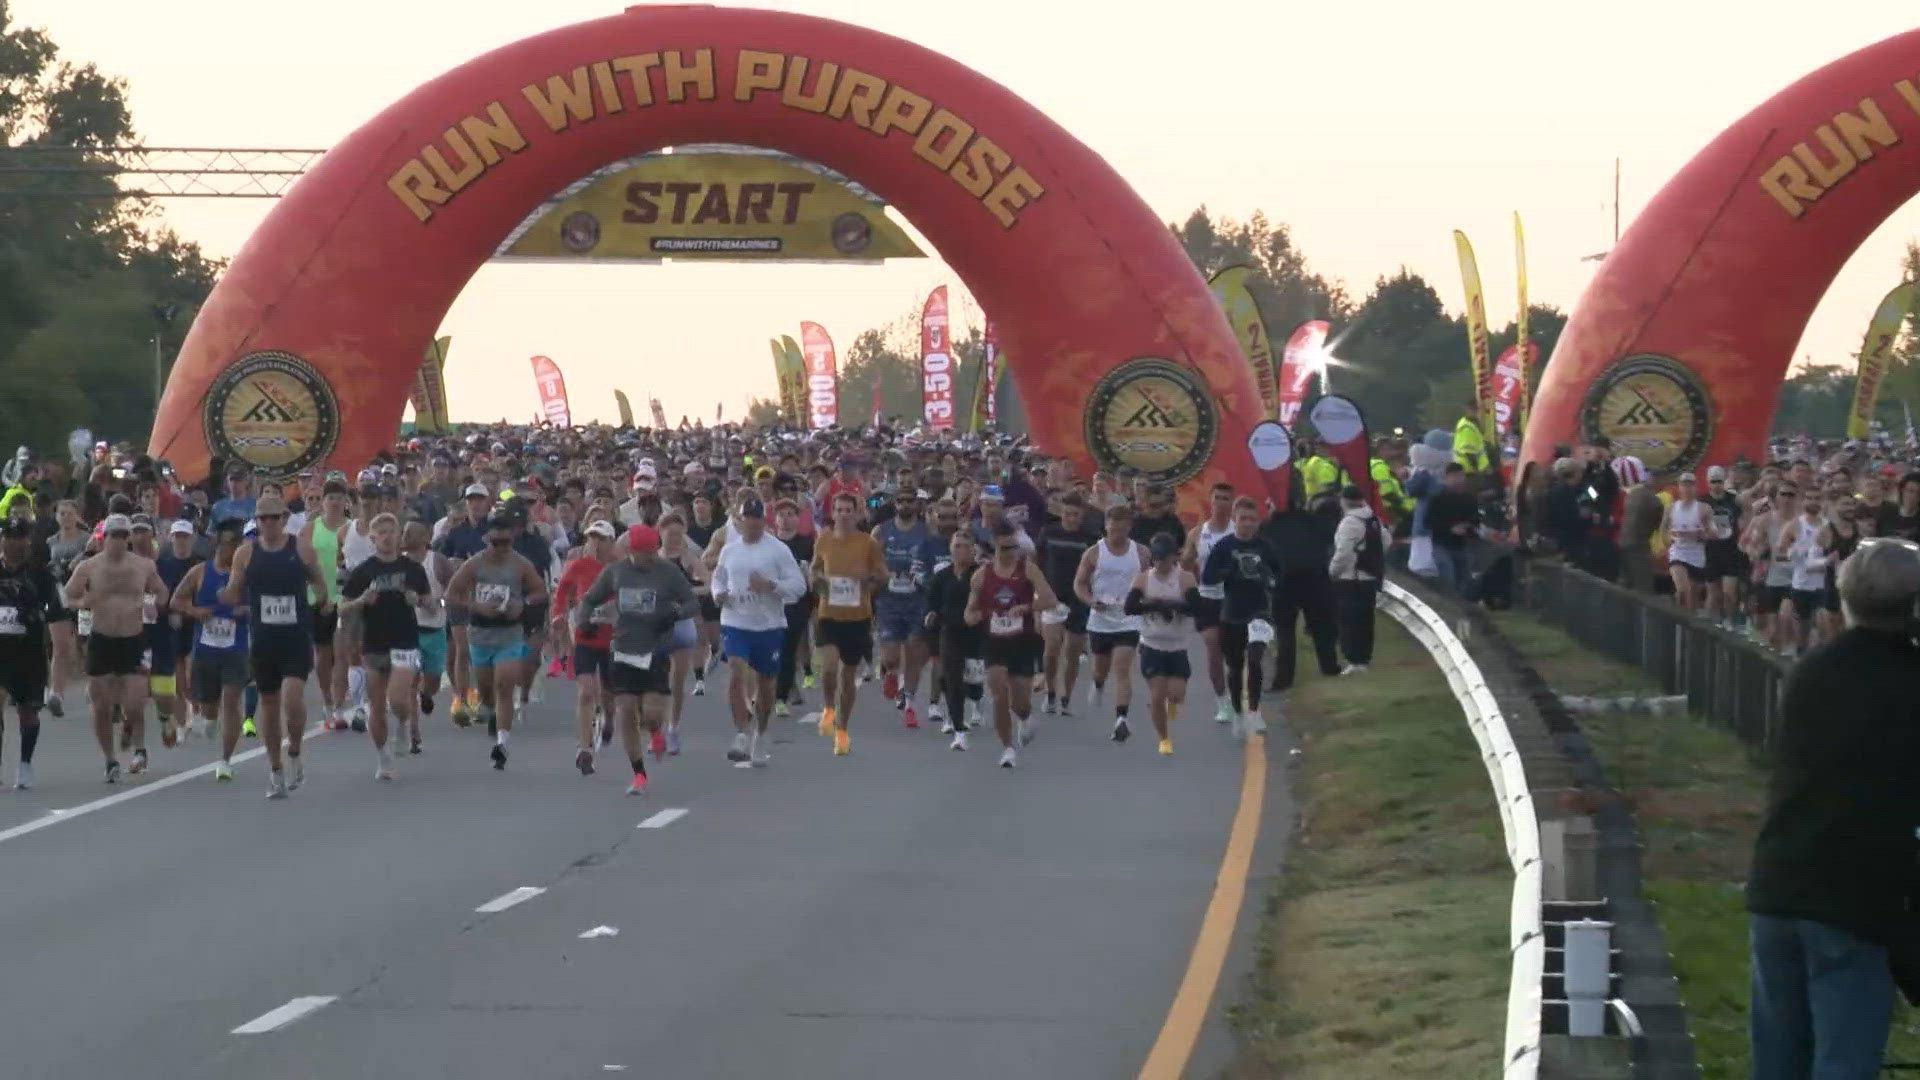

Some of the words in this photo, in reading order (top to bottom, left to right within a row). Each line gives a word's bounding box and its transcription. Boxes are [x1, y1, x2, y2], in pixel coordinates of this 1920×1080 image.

[387, 101, 527, 223] RUN
[523, 48, 715, 132] WITH
[734, 49, 1045, 227] PURPOSE
[1758, 97, 1899, 218] RUN
[622, 181, 815, 225] START
